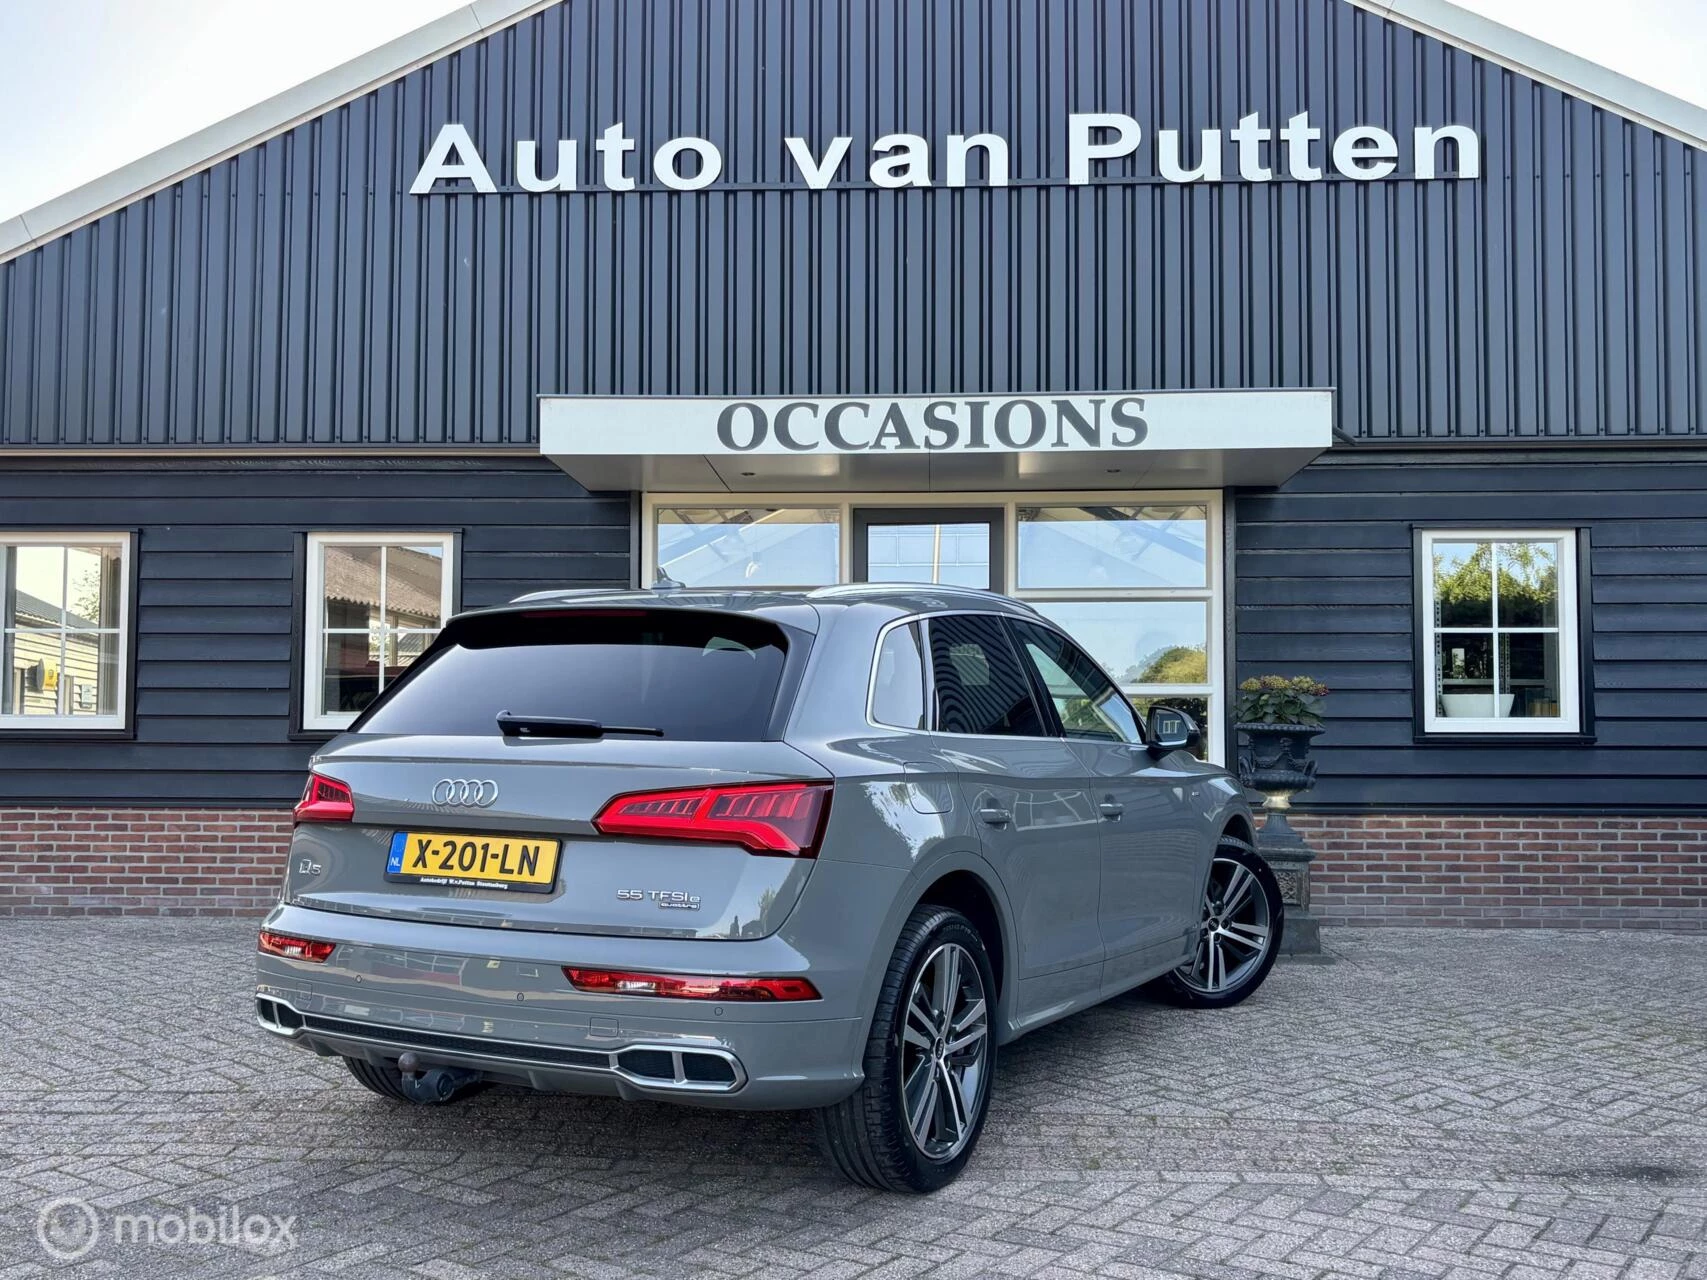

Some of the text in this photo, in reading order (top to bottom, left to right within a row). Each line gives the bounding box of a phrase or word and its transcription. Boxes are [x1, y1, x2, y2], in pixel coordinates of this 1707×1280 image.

[410, 111, 1480, 195] Auto van Putten
[716, 395, 1149, 452] OCCASIONS
[299, 859, 321, 875] Q5
[390, 857, 400, 866] NL
[412, 839, 540, 876] X-201-LN
[617, 889, 642, 900] 55
